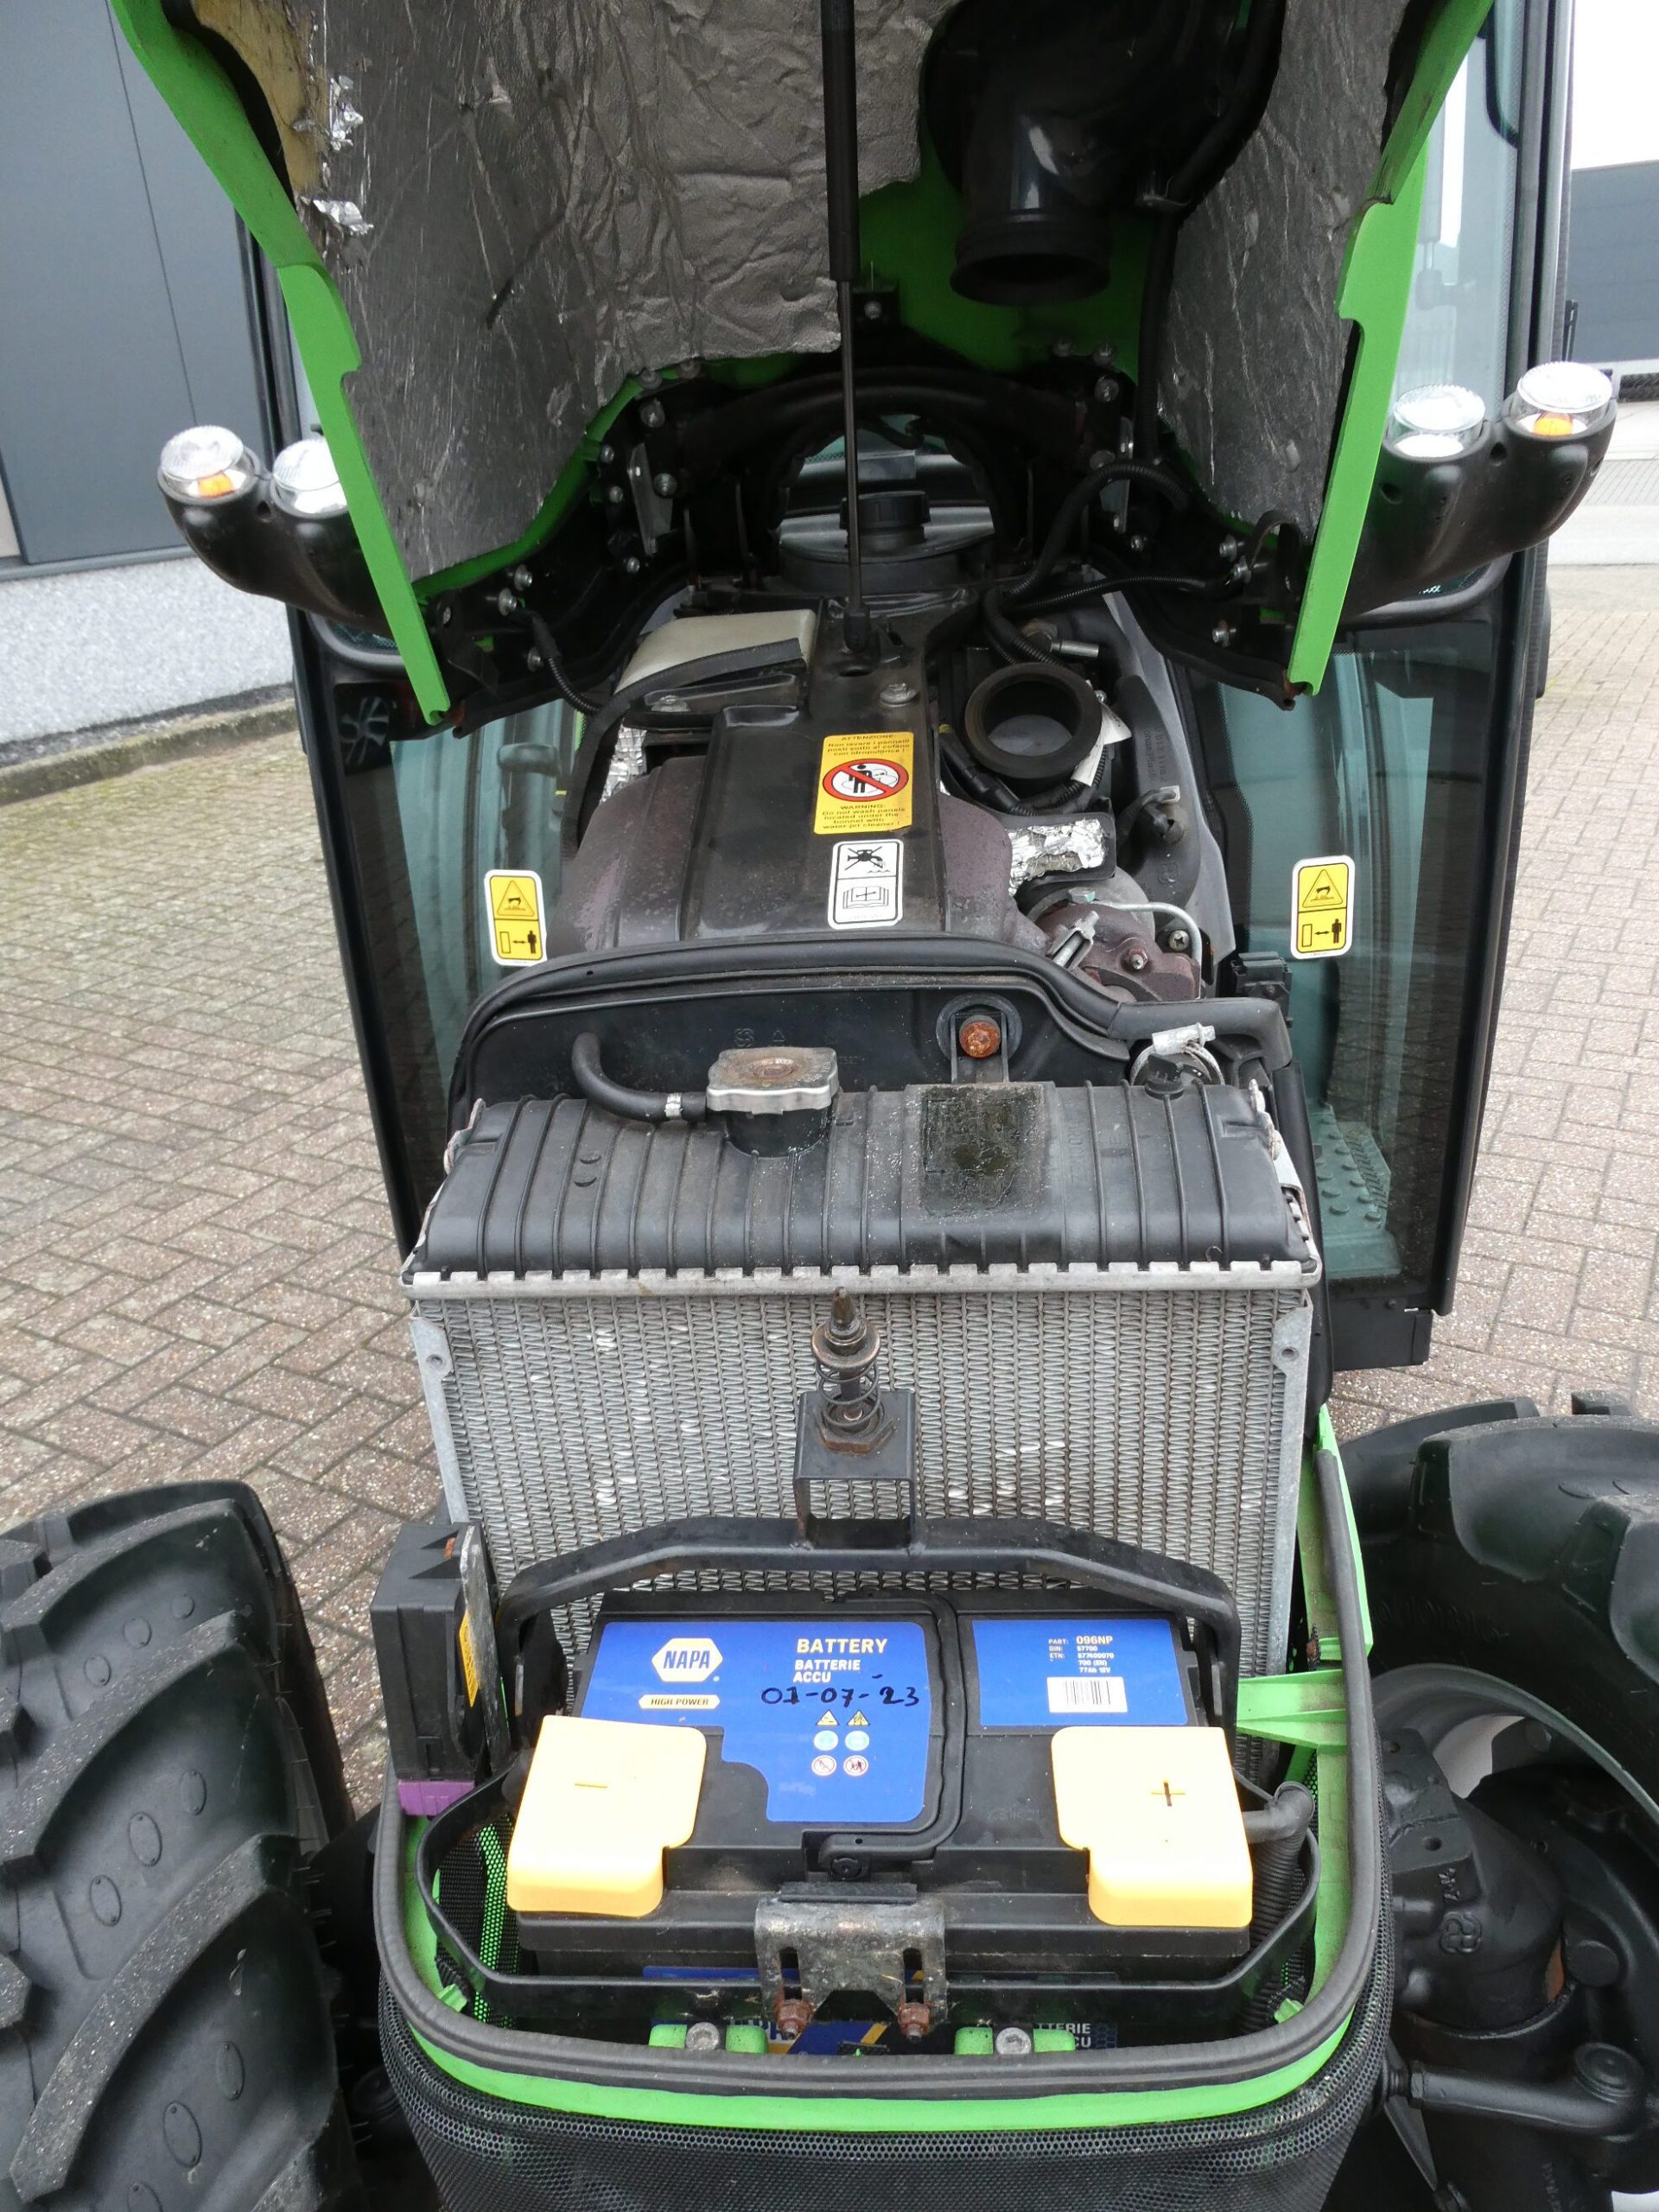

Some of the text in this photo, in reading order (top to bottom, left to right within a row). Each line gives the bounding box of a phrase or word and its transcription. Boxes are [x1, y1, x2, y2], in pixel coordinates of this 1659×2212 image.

[797, 1637, 888, 1654] BATTERY
[1076, 1635, 1114, 1645] 096NP
[663, 1649, 710, 1669] NAPA
[794, 1659, 861, 1671] BATTERIE
[792, 1671, 831, 1683] ACCU
